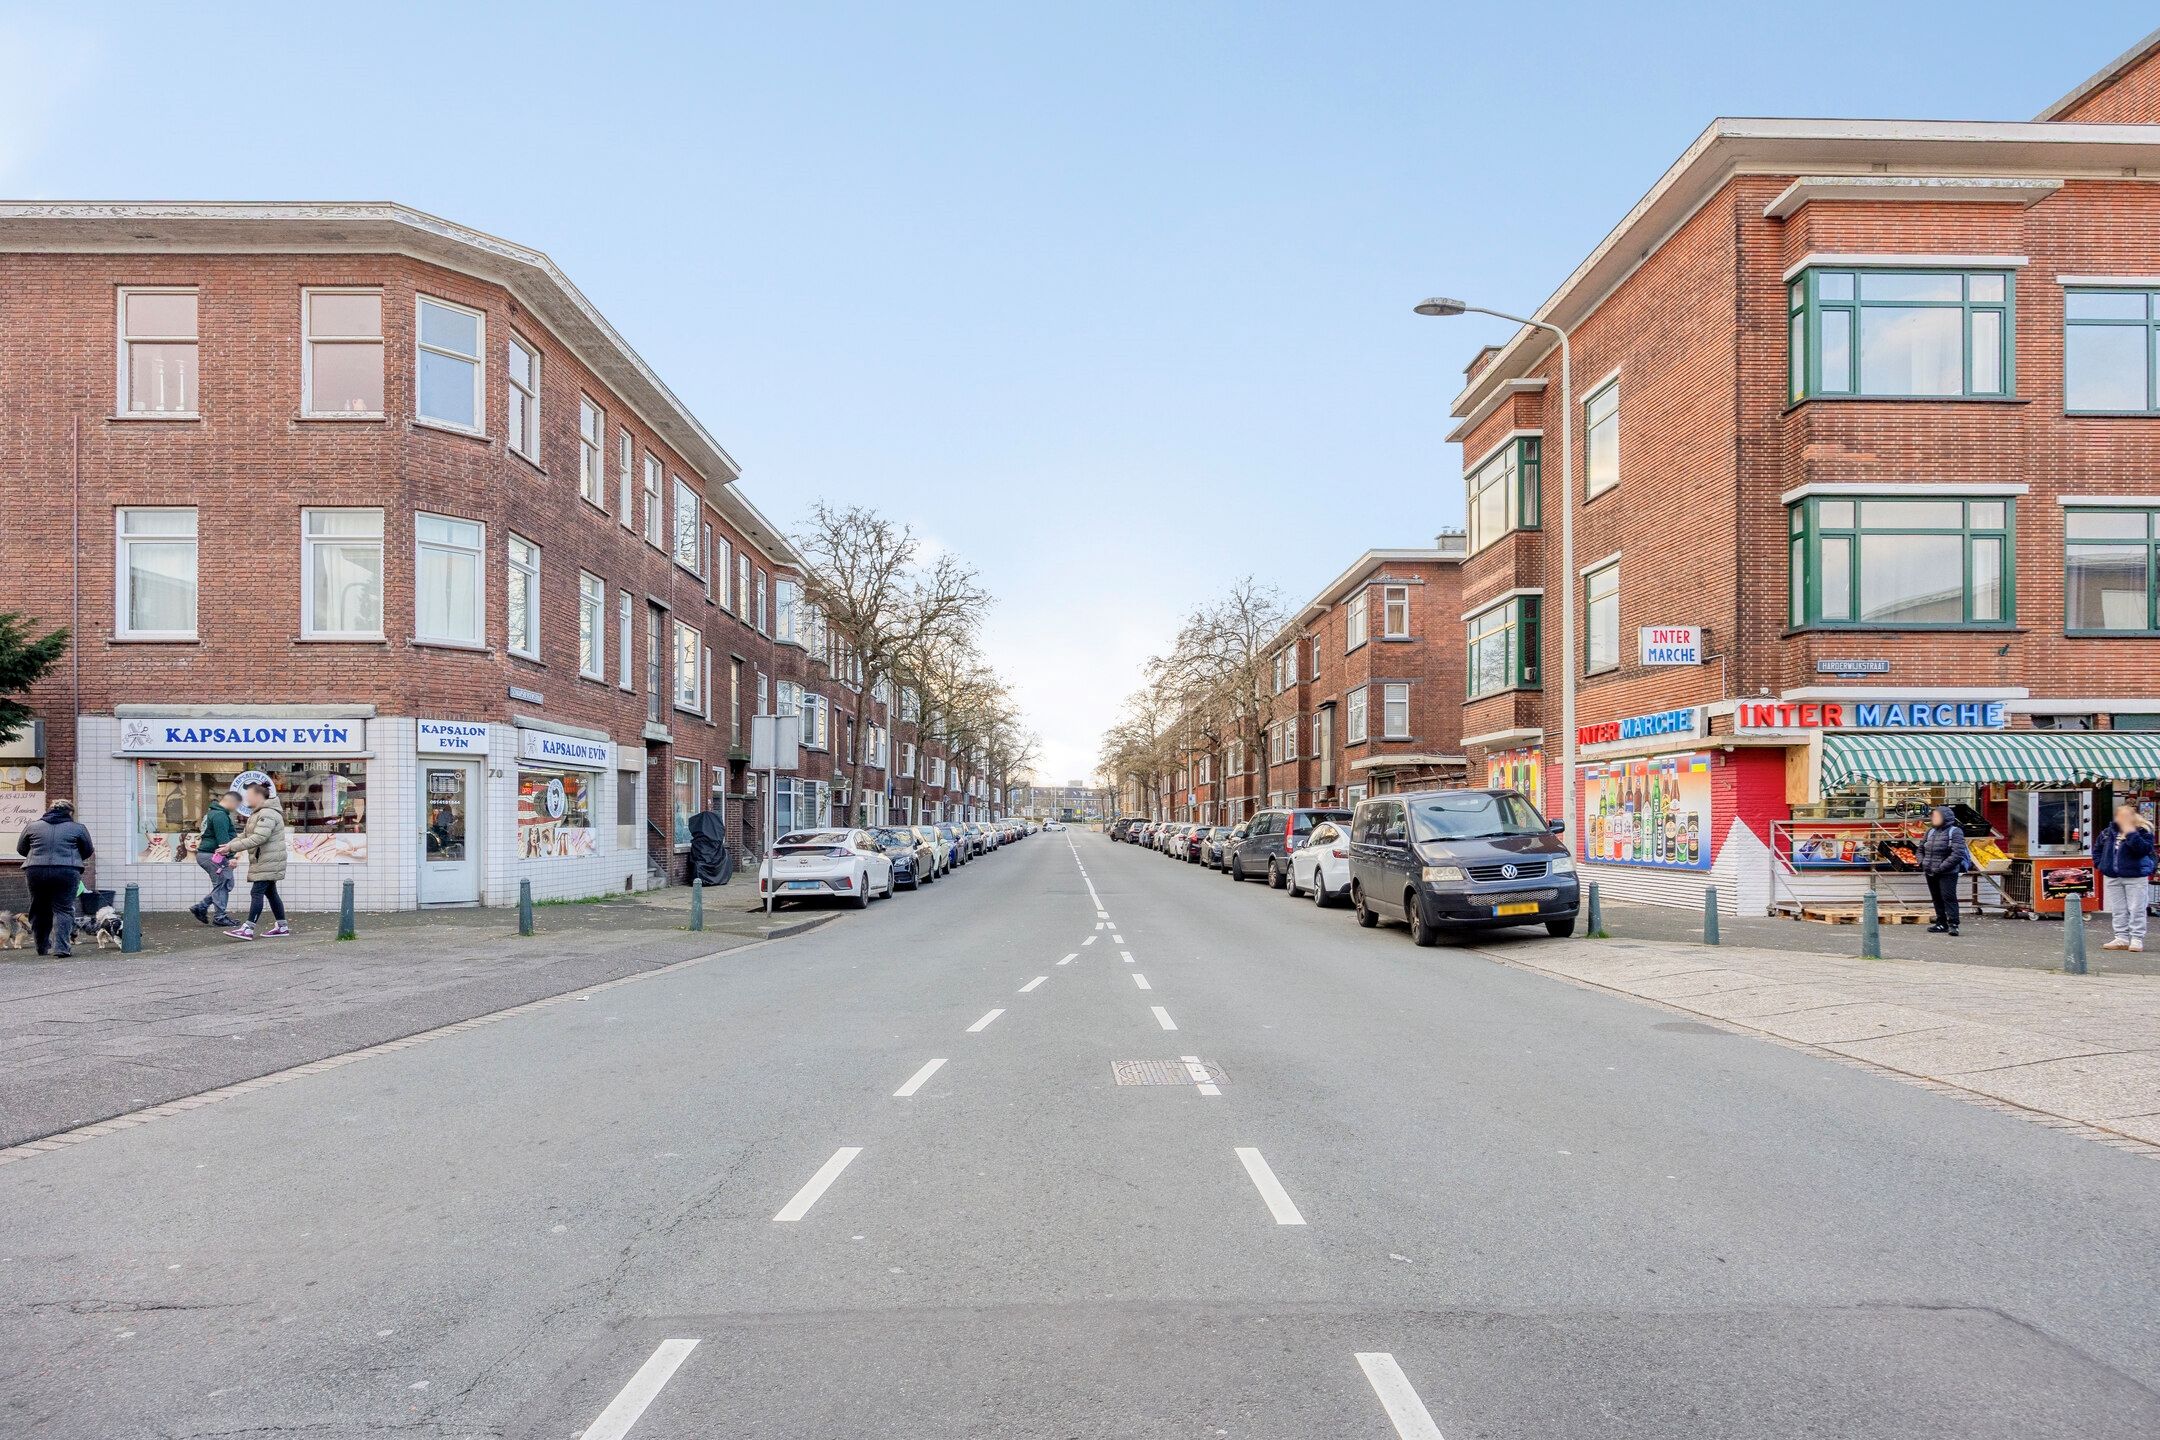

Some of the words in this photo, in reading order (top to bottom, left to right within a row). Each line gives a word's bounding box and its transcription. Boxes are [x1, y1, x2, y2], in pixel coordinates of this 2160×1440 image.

[1652, 630, 1690, 643] INTER
[1648, 648, 1695, 661] MARCHE
[1822, 662, 1886, 670] HARDERWIJKSTRAAT
[1739, 703, 1843, 727] INTER
[1856, 703, 2003, 727] MARCHE
[421, 724, 486, 736] KAPSALON
[1577, 722, 1619, 745] INTER
[1621, 708, 1695, 739] MARCHE
[165, 728, 287, 743] KAPSALON
[542, 739, 587, 758] KAPSALON
[488, 768, 503, 778] 70
